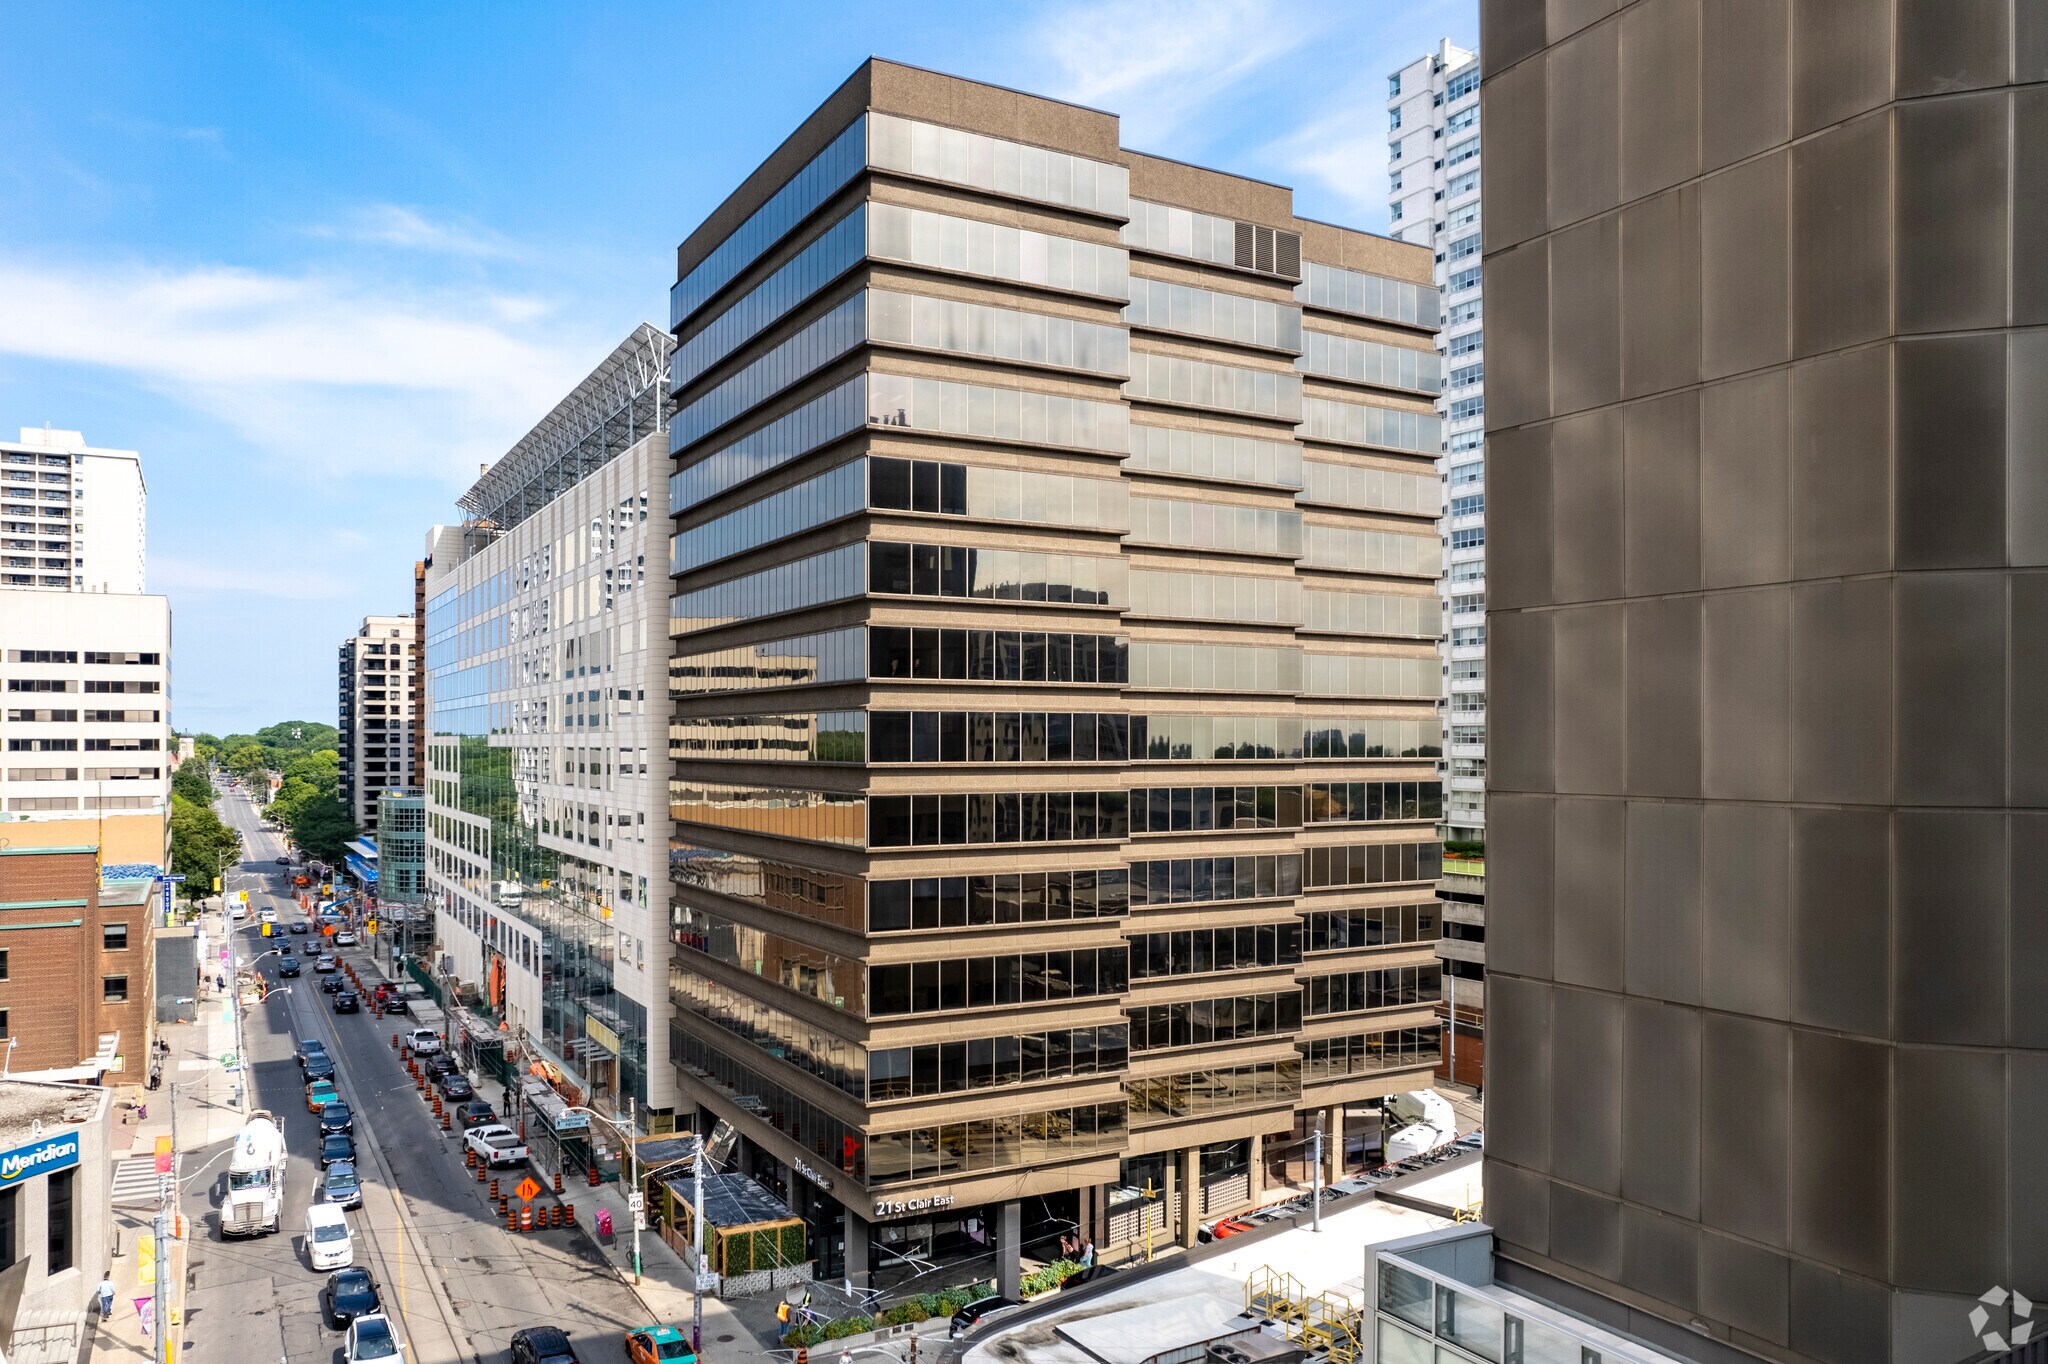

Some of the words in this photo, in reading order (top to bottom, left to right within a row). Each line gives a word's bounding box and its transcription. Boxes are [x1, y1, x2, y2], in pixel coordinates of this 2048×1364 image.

[2, 1142, 76, 1174] Meridian
[630, 1200, 643, 1208] 40
[876, 1200, 892, 1216] 21
[895, 1201, 906, 1213] St
[908, 1198, 932, 1210] Clair
[934, 1195, 954, 1206] East
